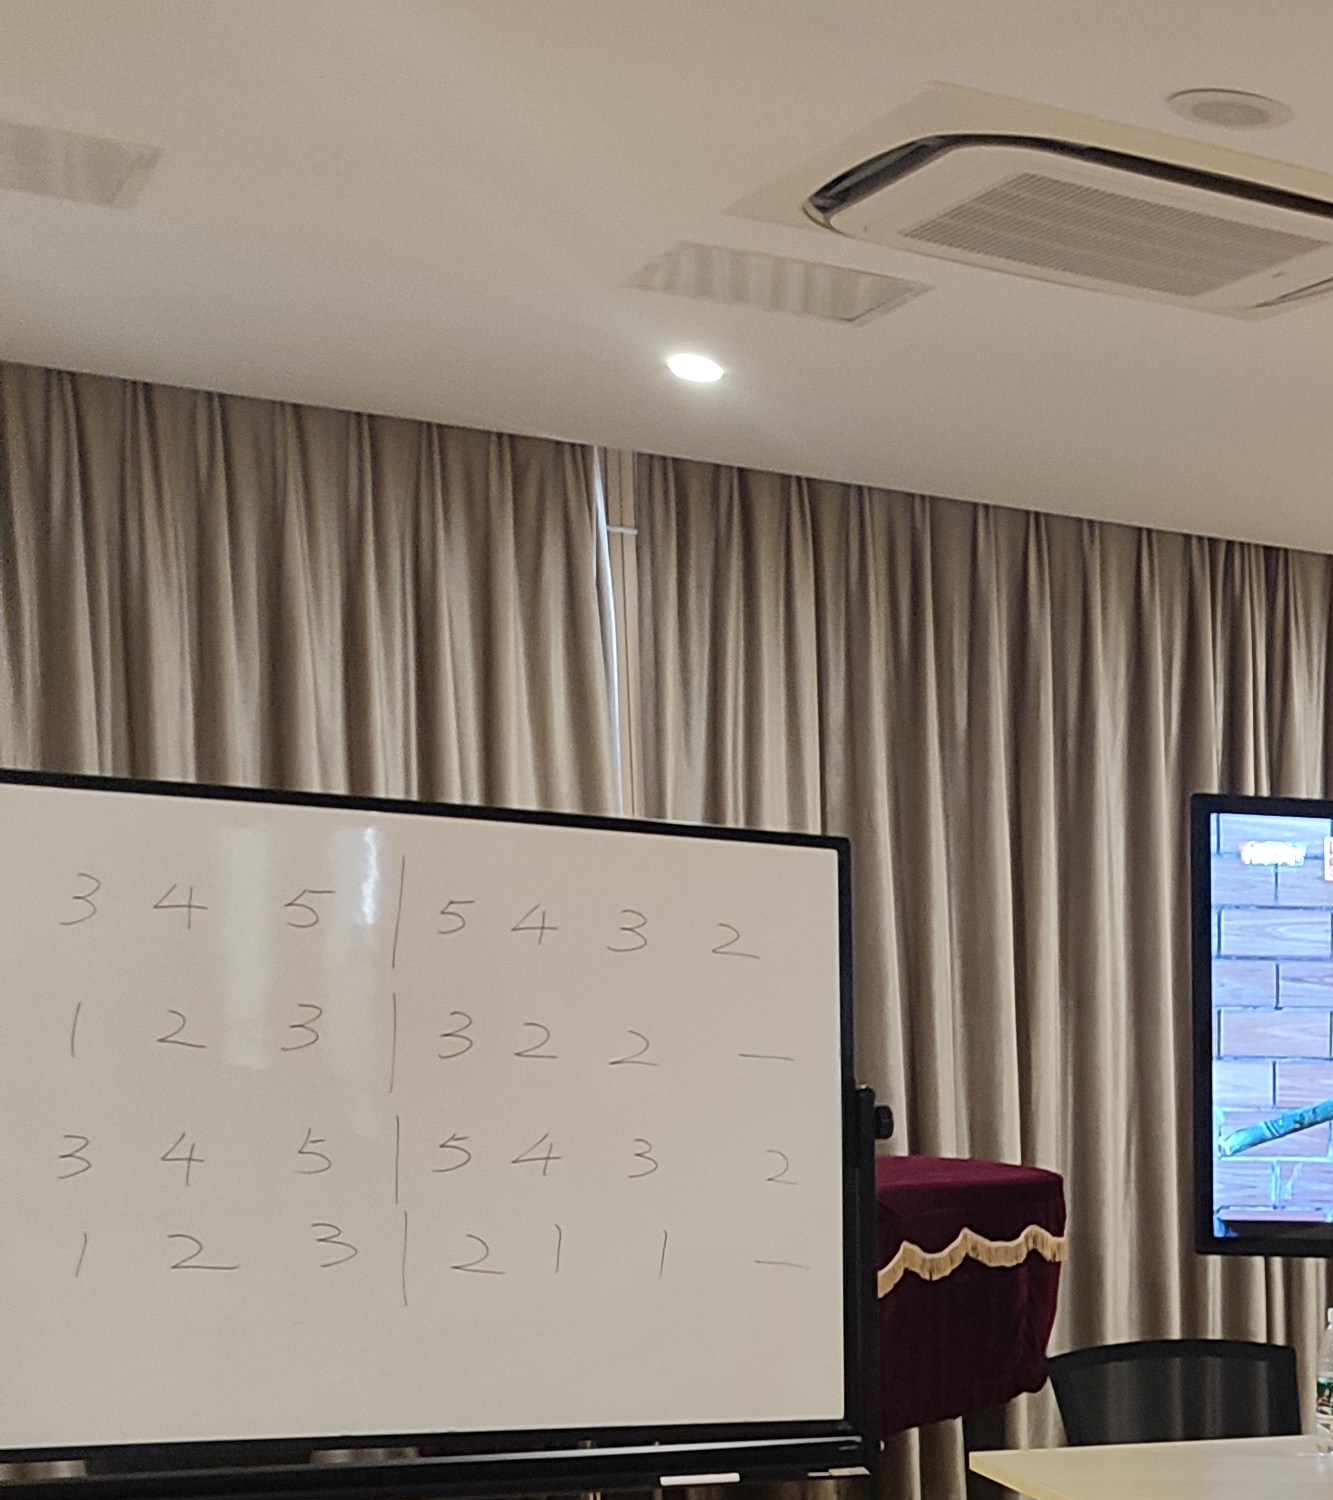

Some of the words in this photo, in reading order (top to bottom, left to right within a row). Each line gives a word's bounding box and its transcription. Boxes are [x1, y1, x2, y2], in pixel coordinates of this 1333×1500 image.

[57, 870, 103, 928] 3
[150, 882, 210, 932] 4
[281, 887, 338, 931] 5
[436, 898, 477, 937] 5
[508, 902, 560, 947] 4
[605, 907, 650, 954] 3
[709, 921, 762, 962] 2
[154, 1007, 209, 1051] 2
[278, 1001, 325, 1054] 3
[436, 1009, 476, 1062] 3
[512, 1020, 560, 1061] 2
[606, 1028, 660, 1068] 2
[55, 1132, 94, 1182] 3
[158, 1130, 207, 1188] 4
[295, 1126, 334, 1177] 5
[430, 1131, 474, 1175] 5
[509, 1131, 564, 1179] 4
[626, 1136, 661, 1180] 3
[764, 1147, 800, 1187] 2
[165, 1231, 242, 1272] 2
[309, 1221, 360, 1270] 3
[449, 1232, 507, 1277] 2
